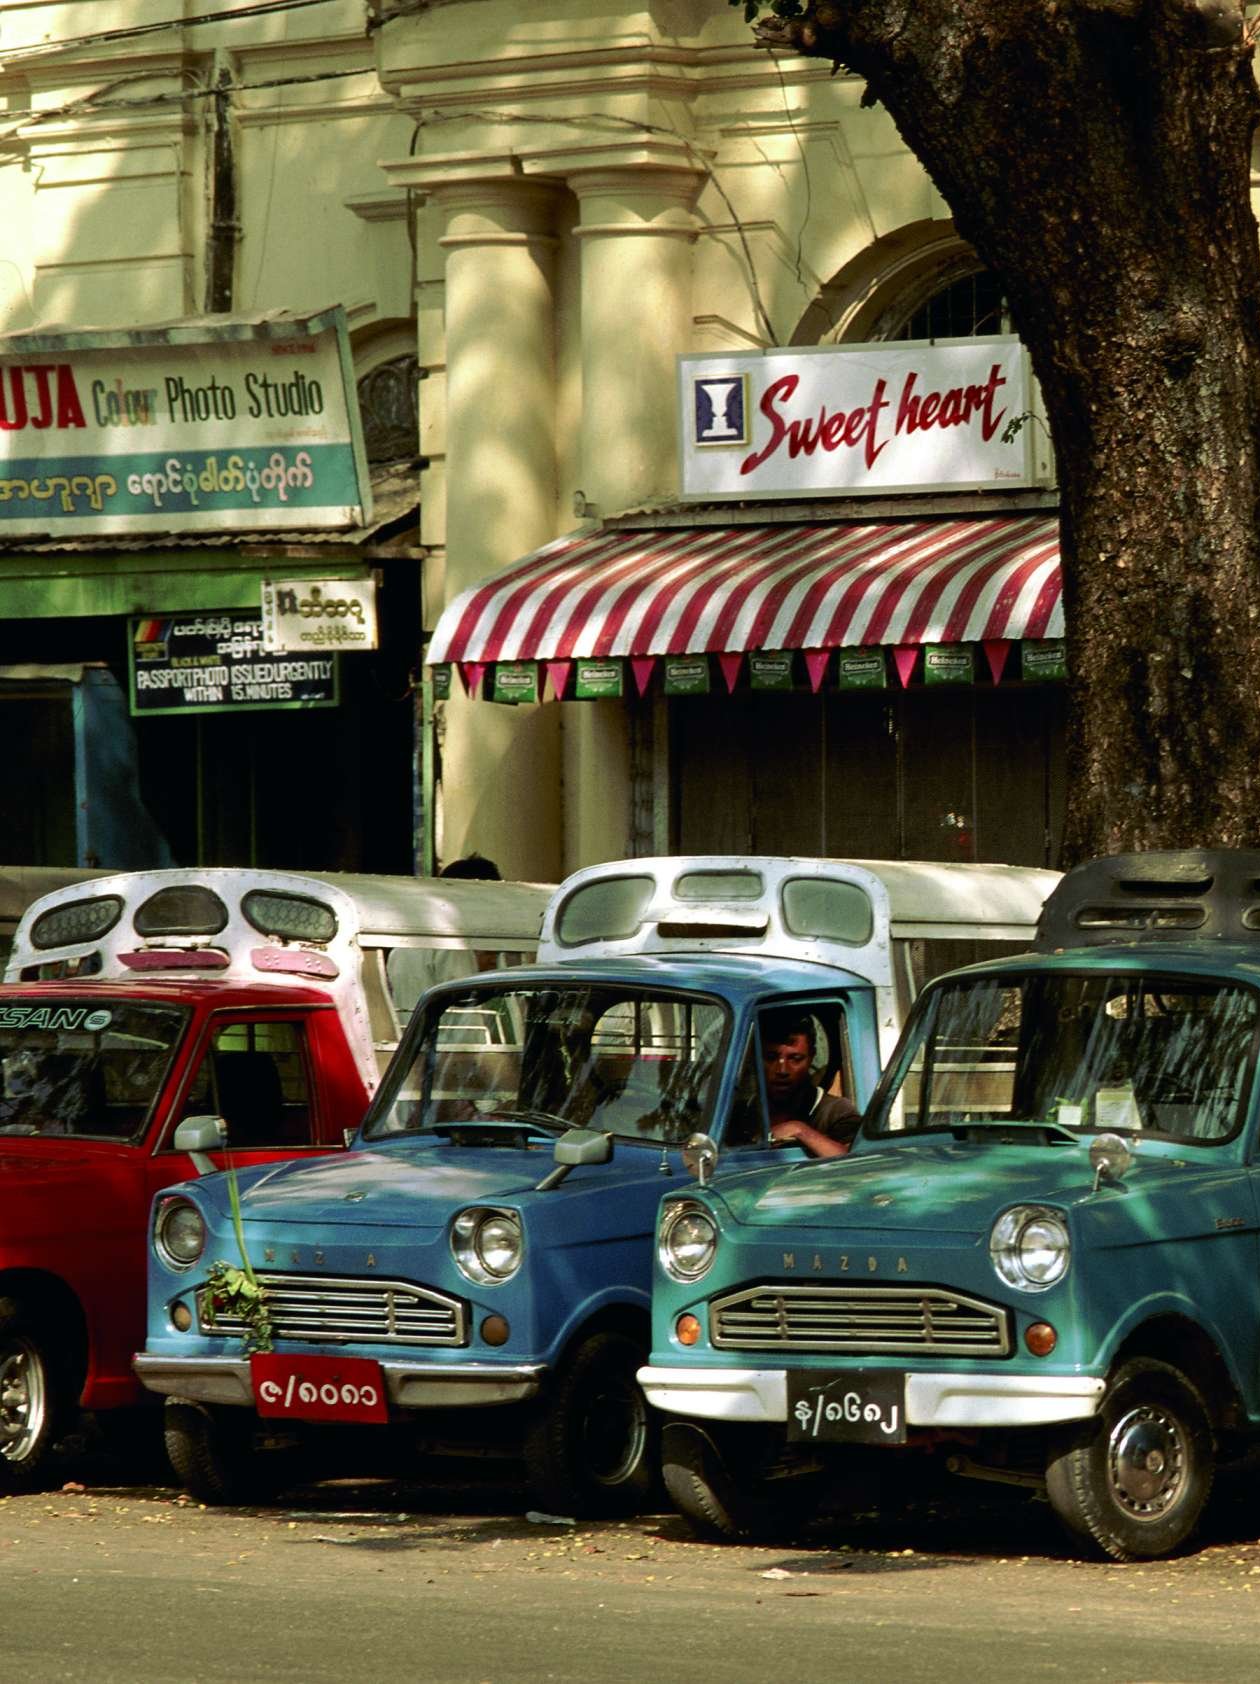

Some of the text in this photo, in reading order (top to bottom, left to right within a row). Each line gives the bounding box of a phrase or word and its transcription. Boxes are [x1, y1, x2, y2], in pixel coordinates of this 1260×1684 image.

[91, 378, 158, 428] Colour
[164, 375, 237, 424] Photo
[244, 370, 324, 419] Studio
[740, 363, 1008, 475] Sweet heart
[136, 660, 333, 689] PASSPORT PHOTO ISSUED URGENTLY
[183, 686, 224, 702] WITHIN
[0, 1007, 88, 1029] SAN
[783, 1252, 908, 1272] MAZDA
